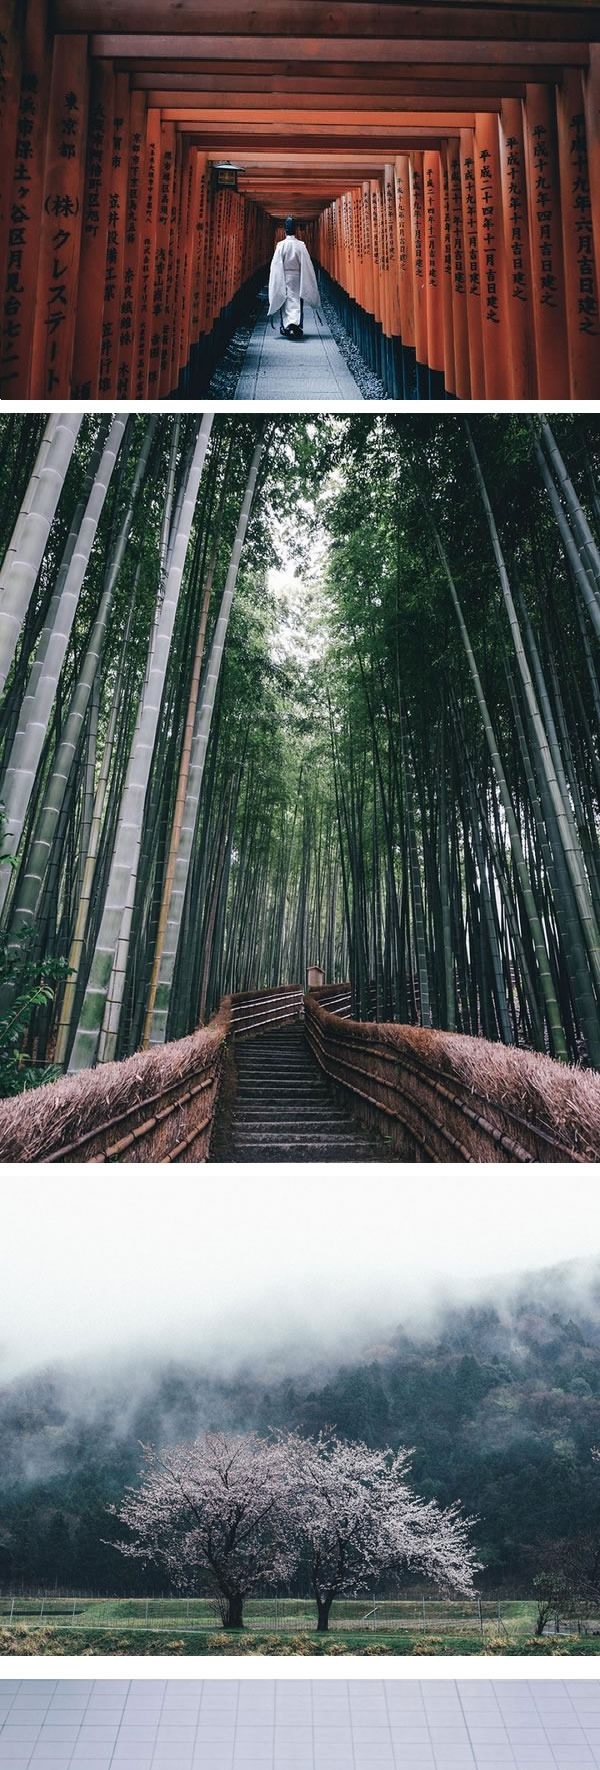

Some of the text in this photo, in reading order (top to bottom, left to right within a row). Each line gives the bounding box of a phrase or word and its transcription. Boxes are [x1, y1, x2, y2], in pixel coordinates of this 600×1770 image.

[58, 90, 79, 161] 東京都
[464, 157, 481, 296] 平成十九年十一月吉日建之
[479, 149, 500, 324] 平成二十四年十一月吉日建之
[505, 137, 529, 302] 平成十九年十月吉日建之
[532, 124, 559, 308] 平成十九年四月吉日建之
